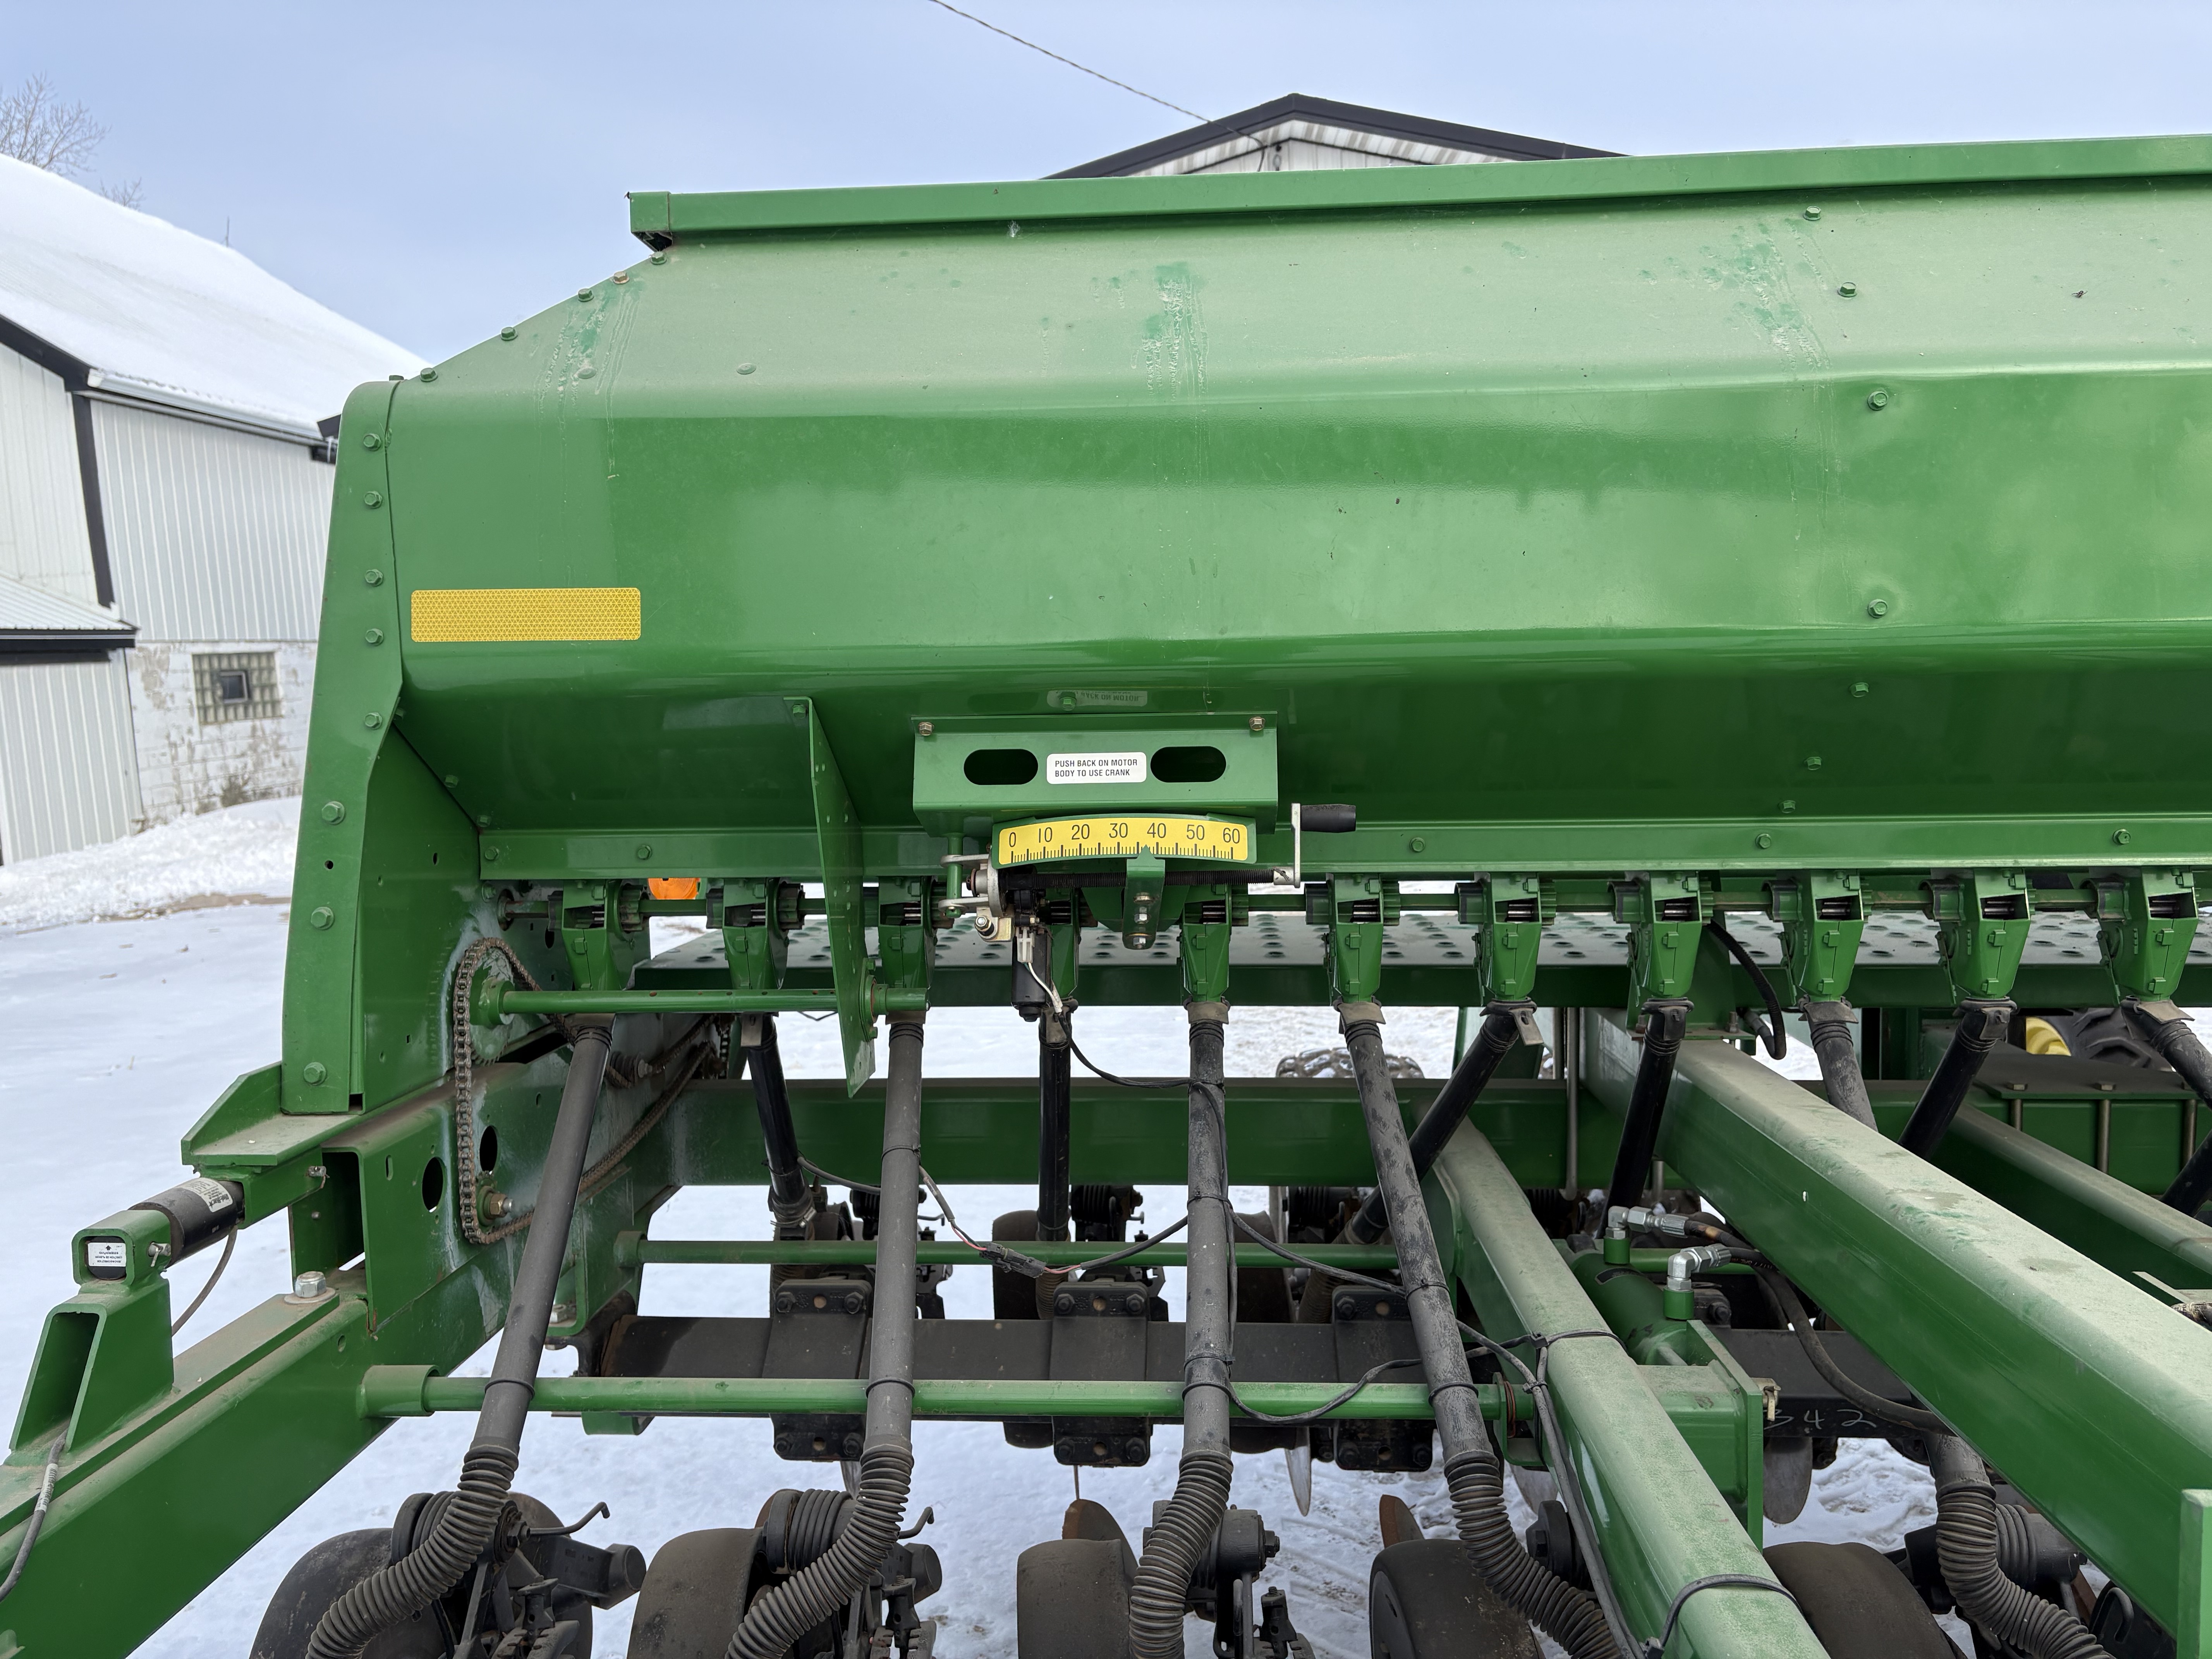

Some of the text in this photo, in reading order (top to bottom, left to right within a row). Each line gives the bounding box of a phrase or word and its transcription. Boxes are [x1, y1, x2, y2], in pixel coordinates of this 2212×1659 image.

[1009, 823, 1240, 847] 0 10 20 30 40 50 60
